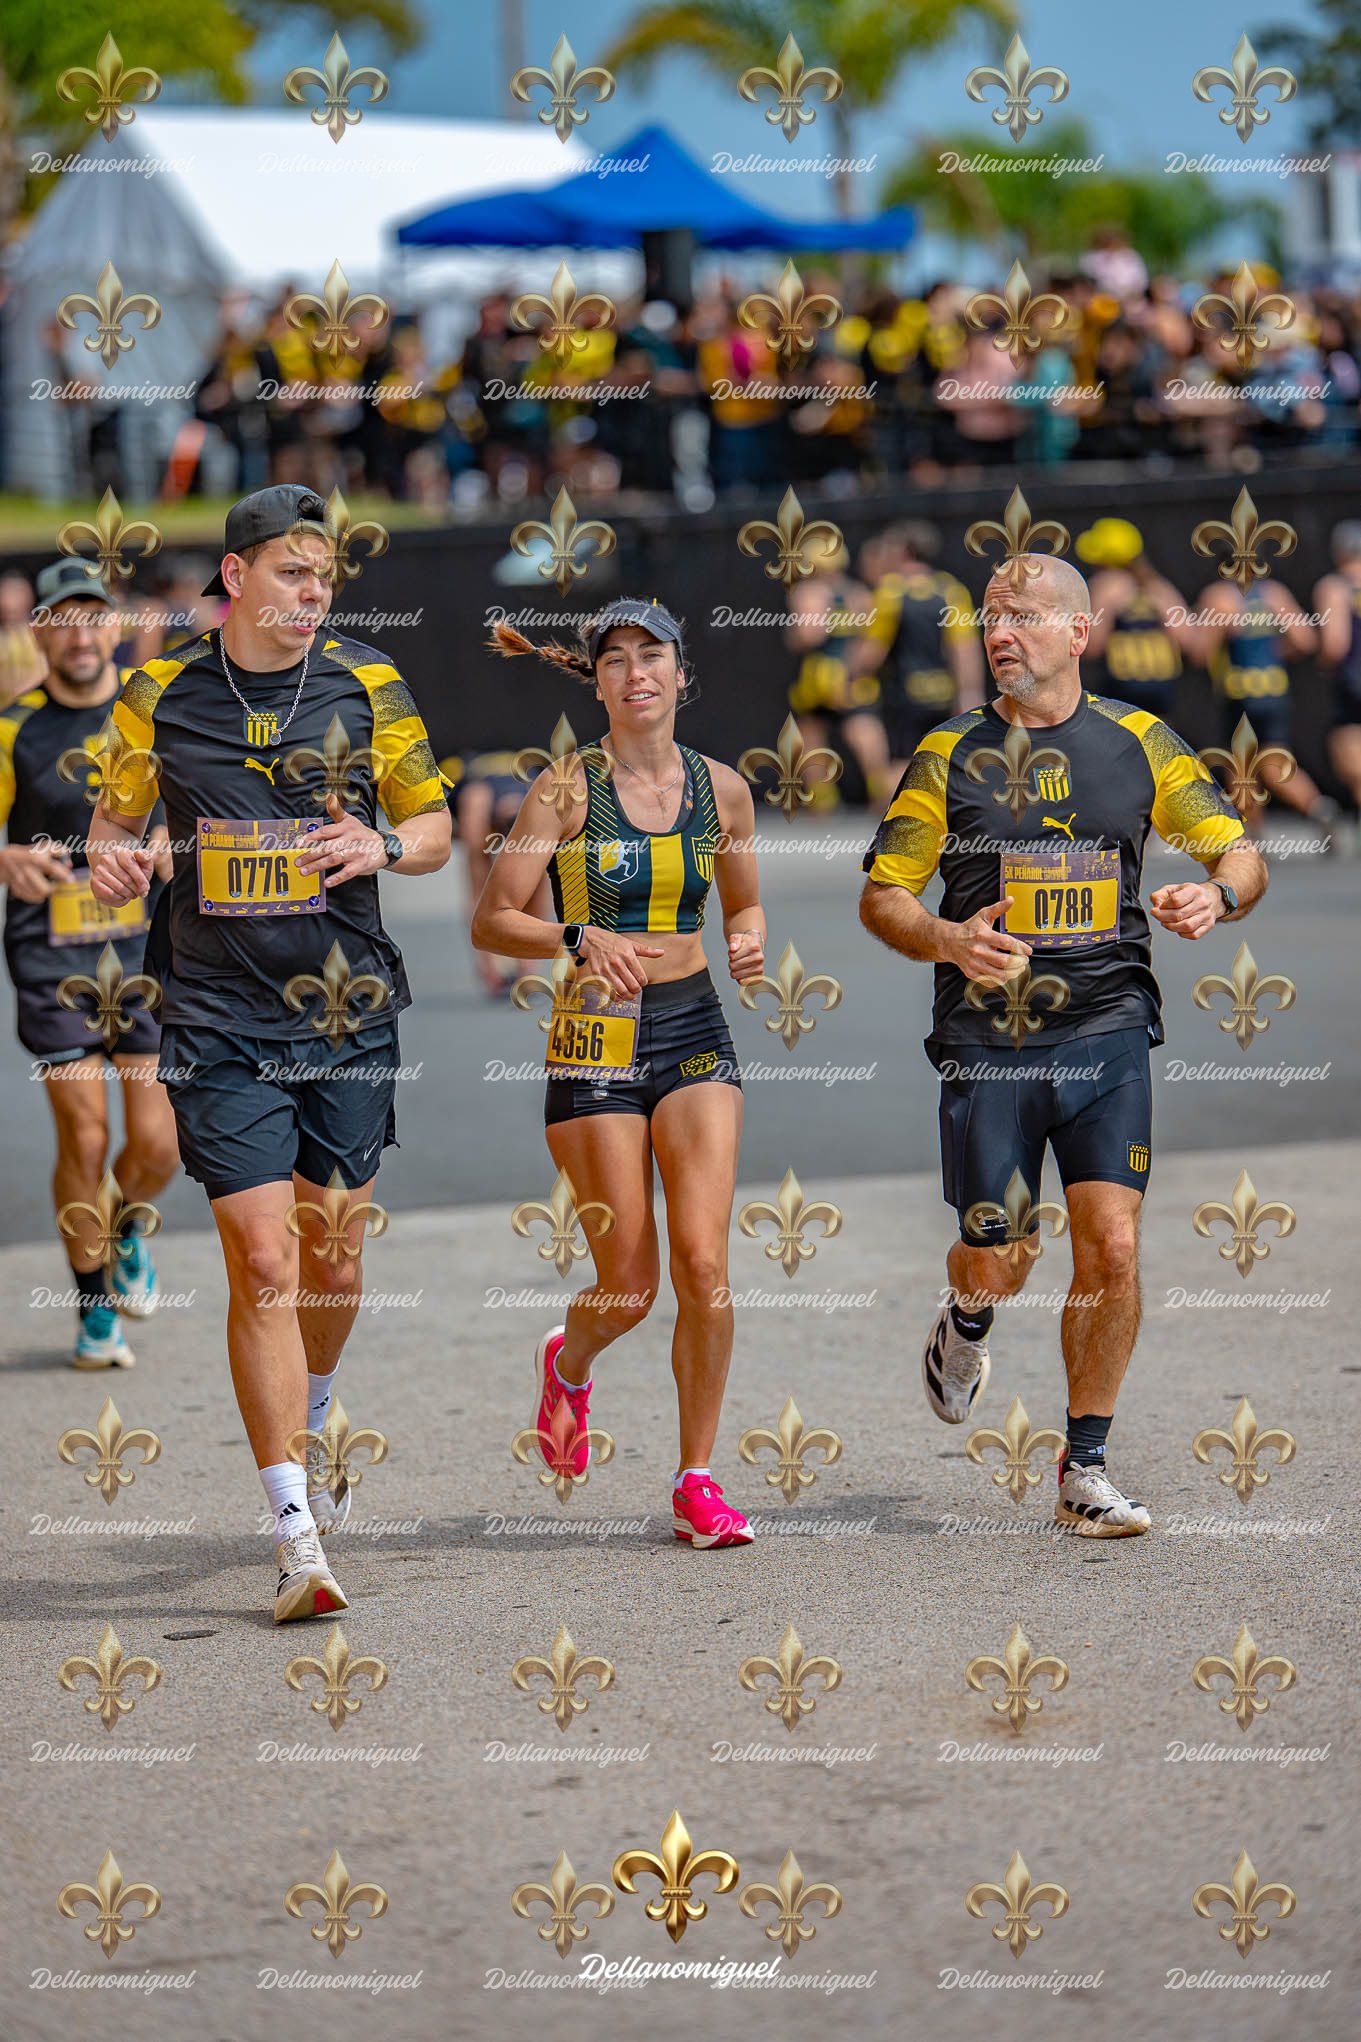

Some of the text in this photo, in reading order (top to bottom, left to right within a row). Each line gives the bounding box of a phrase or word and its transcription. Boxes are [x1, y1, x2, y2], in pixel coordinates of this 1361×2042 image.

[228, 856, 288, 898] 0776
[1035, 888, 1093, 929] 0788
[552, 1018, 605, 1061] 4356
